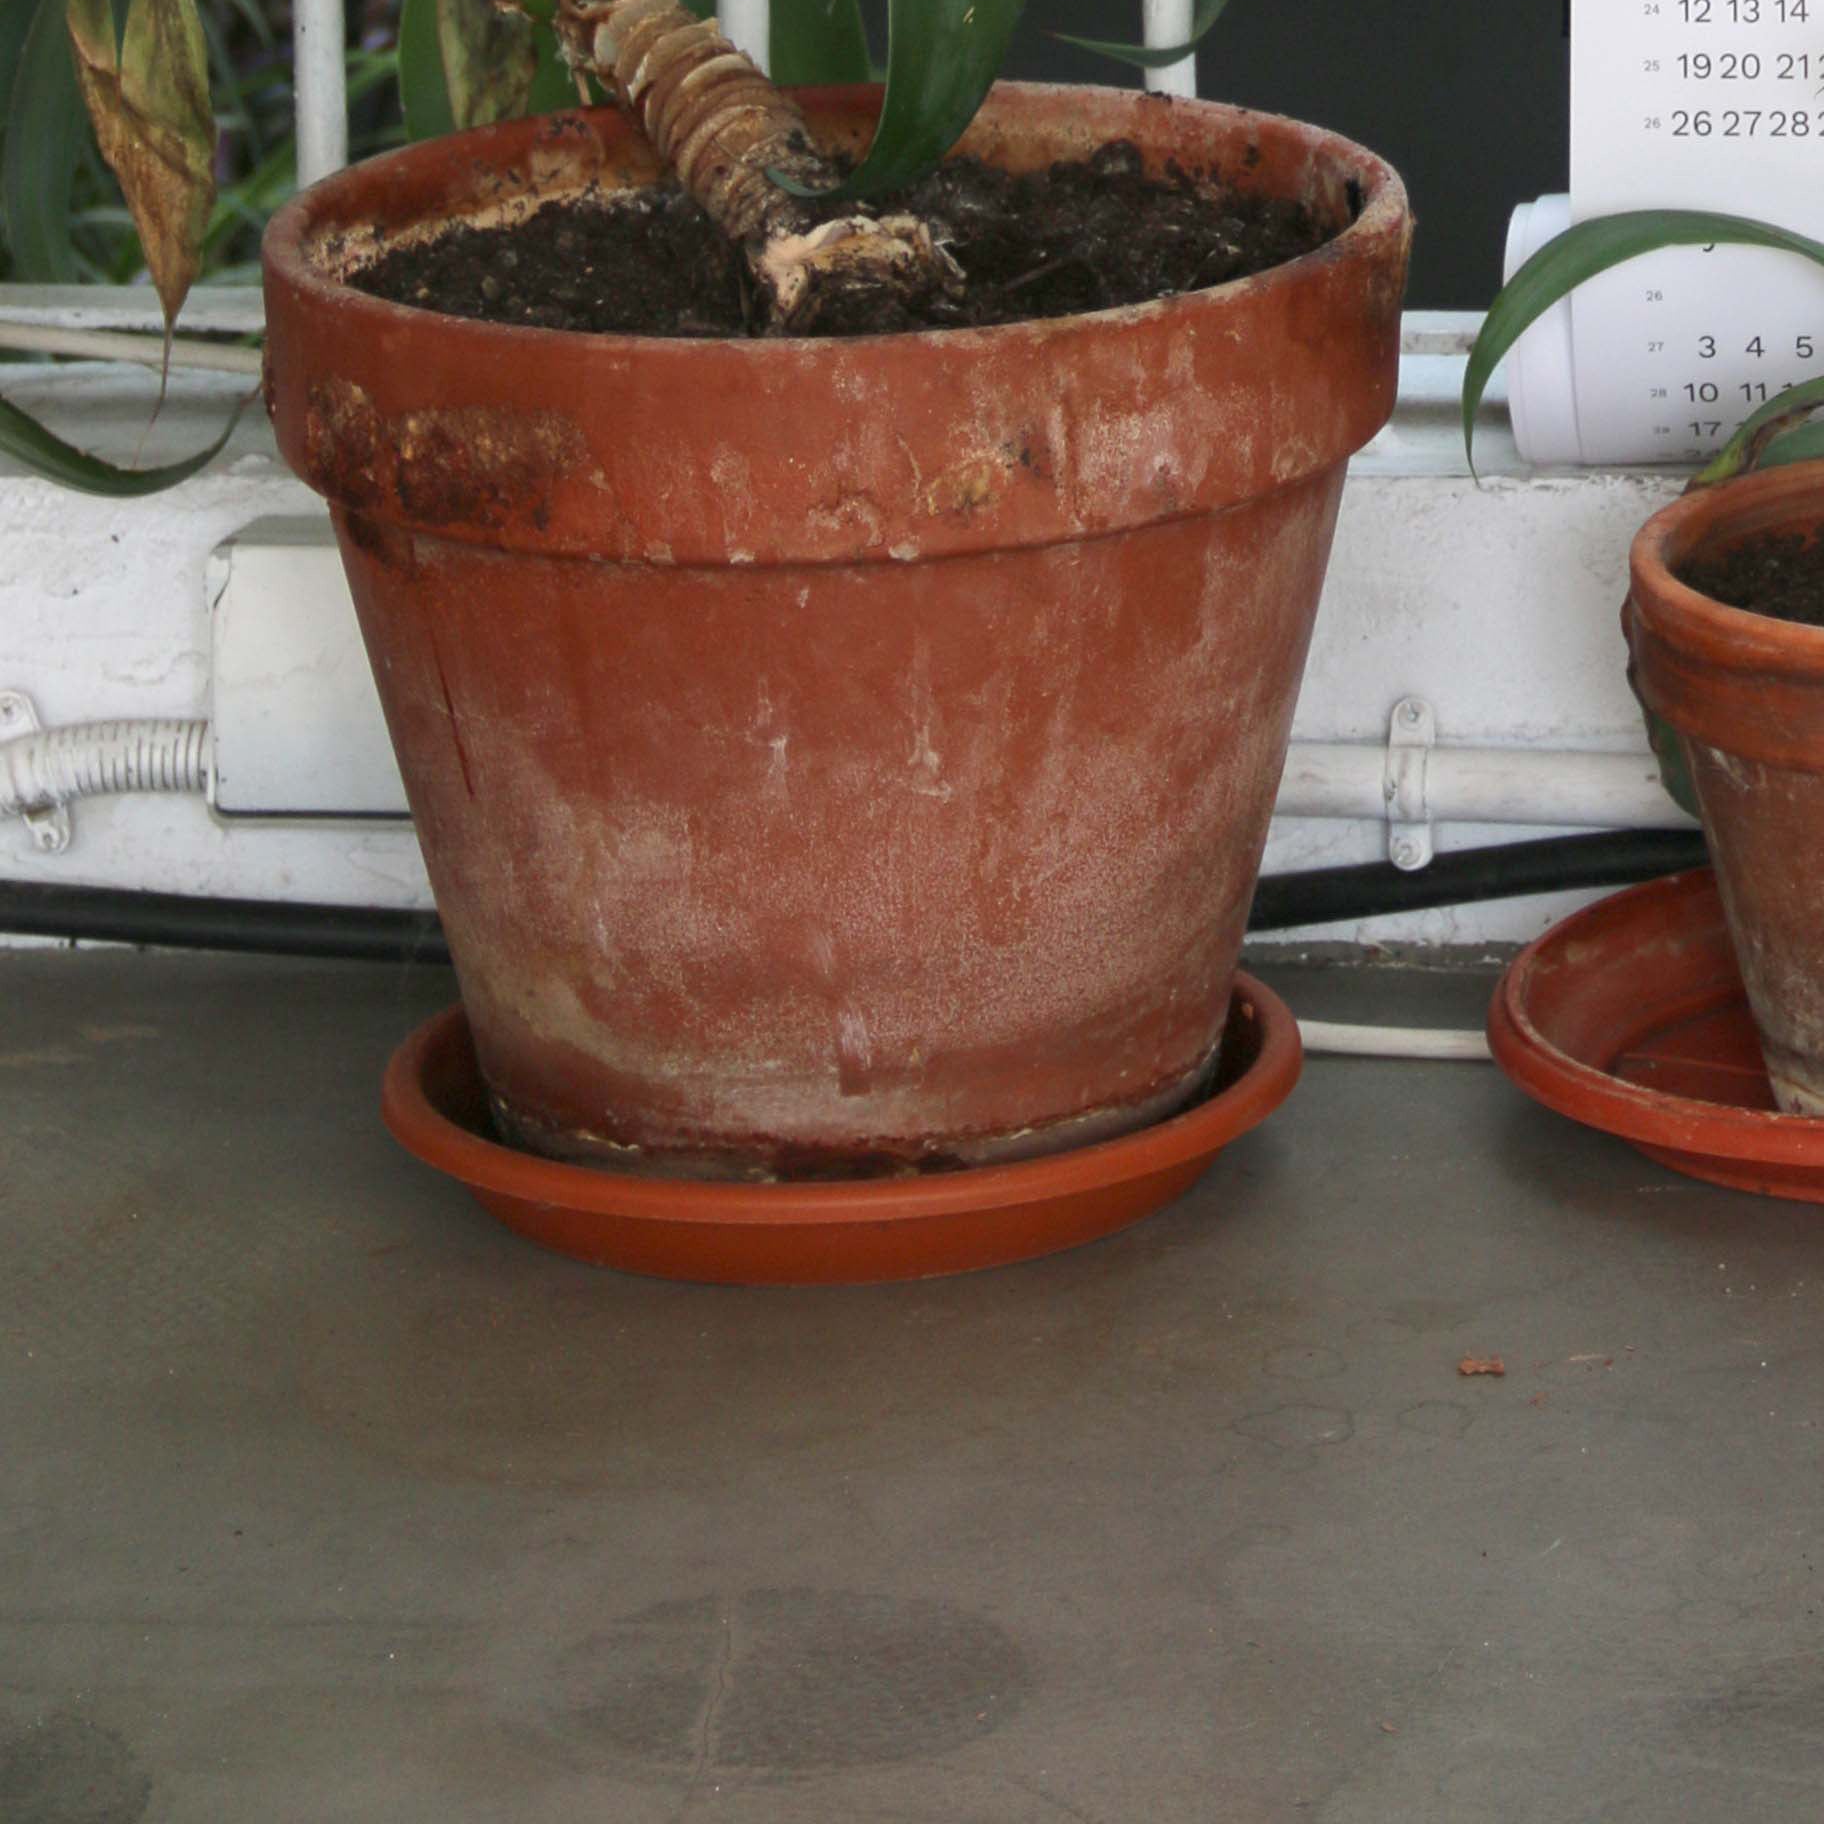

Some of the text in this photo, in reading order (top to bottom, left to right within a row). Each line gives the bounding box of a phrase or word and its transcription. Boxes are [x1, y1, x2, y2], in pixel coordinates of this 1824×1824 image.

[1678, 53, 1711, 79] 19
[1720, 53, 1760, 79] 20
[1777, 54, 1808, 79] 21
[1672, 110, 1712, 136] 26
[1723, 111, 1762, 136] 27
[1769, 111, 1809, 136] 28
[1698, 335, 1717, 359] 3
[1745, 335, 1765, 358] 4
[1796, 335, 1814, 359] 5
[1683, 382, 1719, 403] 10
[1739, 382, 1766, 402] 11
[1688, 420, 1722, 437] 17
